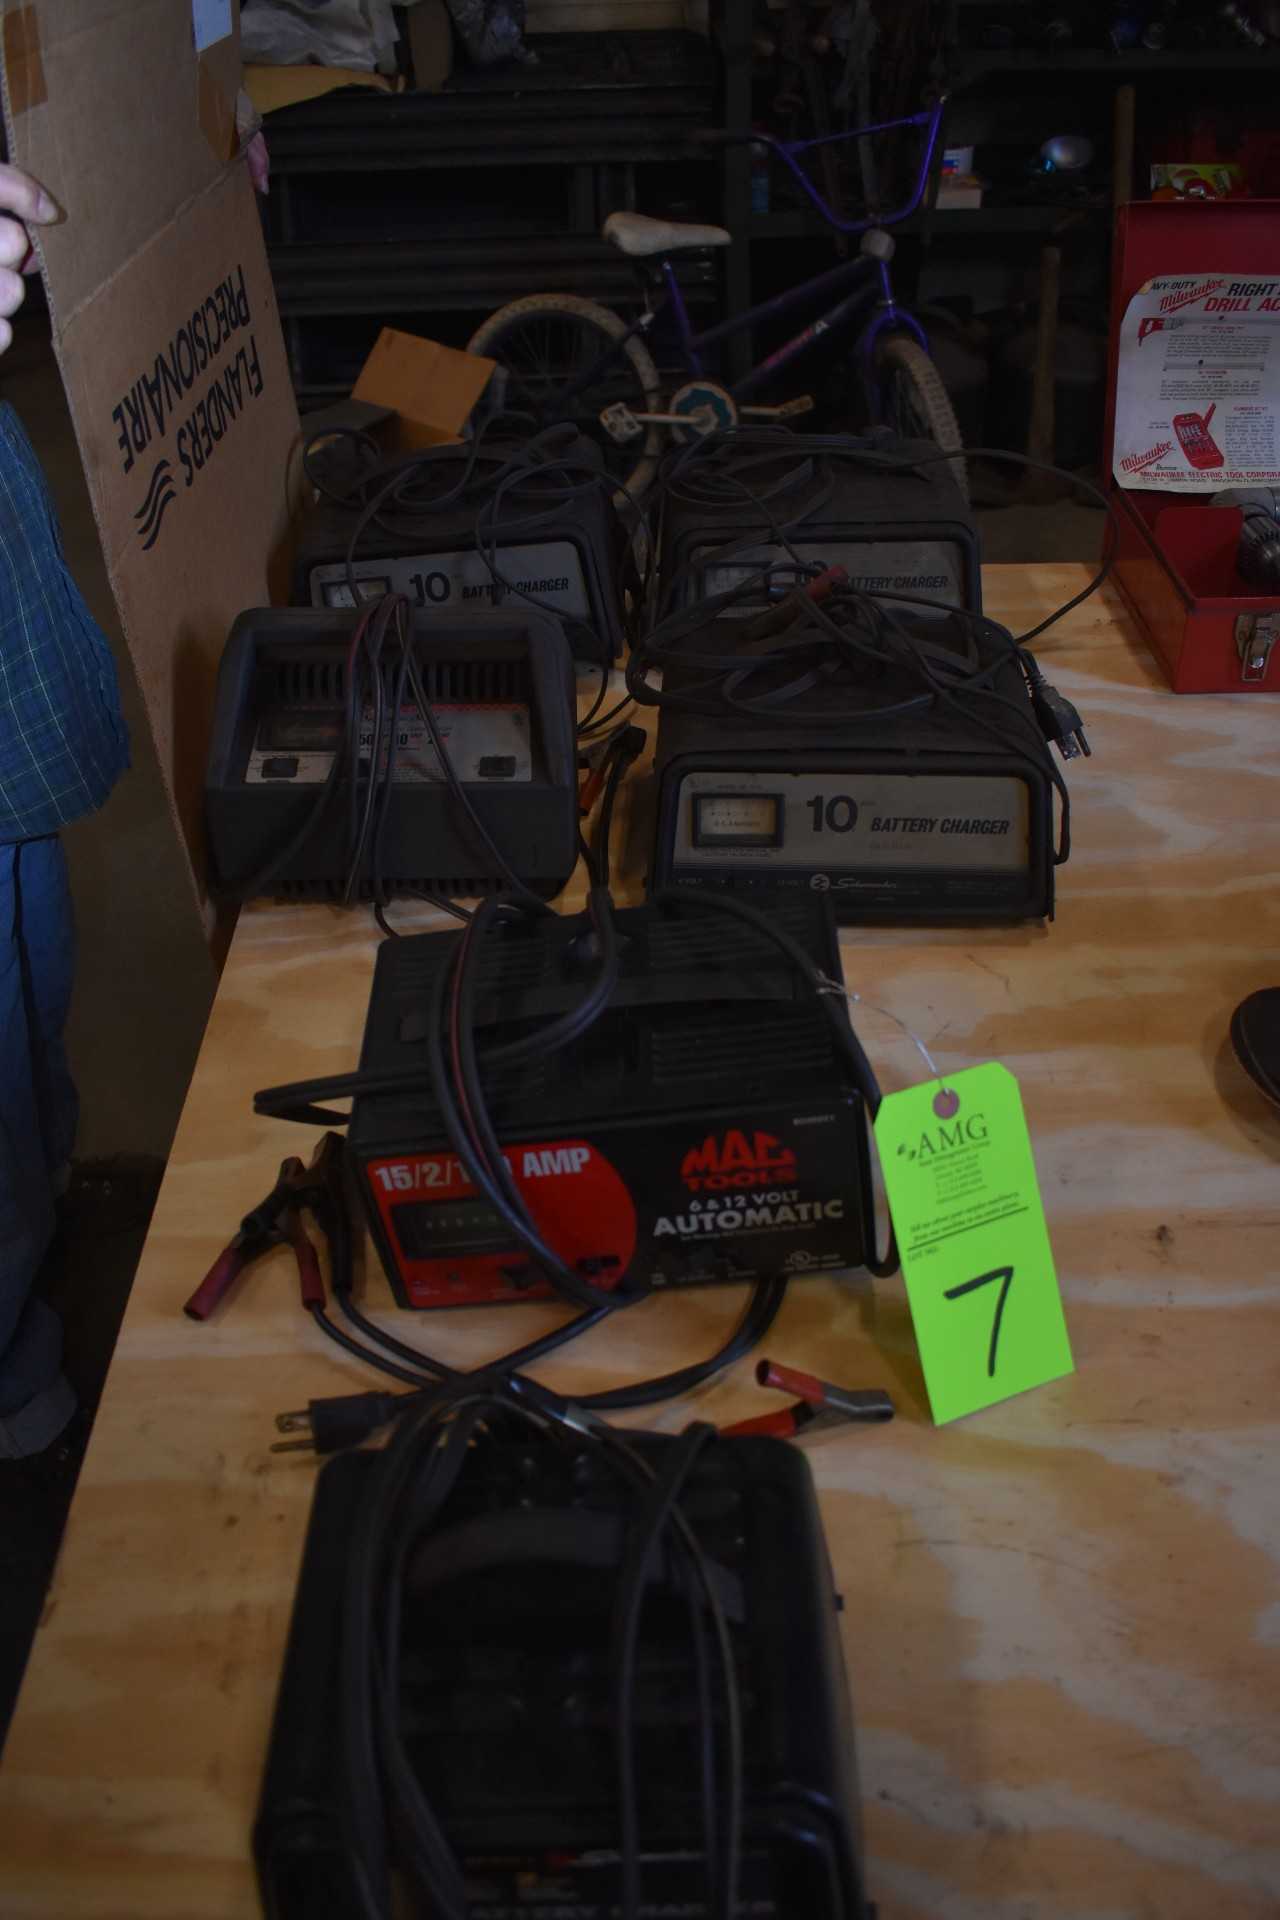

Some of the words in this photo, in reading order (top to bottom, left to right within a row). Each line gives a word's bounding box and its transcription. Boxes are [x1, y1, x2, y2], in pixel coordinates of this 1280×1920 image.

[1204, 297, 1250, 312] DRILL
[112, 264, 250, 474] PRECISIONAIRE
[177, 335, 264, 486] FLANDERS
[1120, 441, 1174, 474] Milwaukee
[409, 571, 450, 606] 10
[515, 577, 569, 593] CHARGER
[893, 575, 949, 590] CHARGER
[807, 795, 858, 833] 10
[871, 817, 938, 833] BATTERY
[940, 818, 1010, 835] CHARGER
[681, 1127, 798, 1174] MAC
[917, 1112, 988, 1160] AMG
[522, 1146, 591, 1179] AMP
[684, 1167, 798, 1192] TOOLS
[653, 1200, 844, 1237] AUTOMATIC
[689, 1199, 702, 1212] 6
[706, 1196, 720, 1210] &
[723, 1193, 747, 1209] 12
[751, 1189, 800, 1206] VOLT
[944, 1266, 1014, 1379] 7
